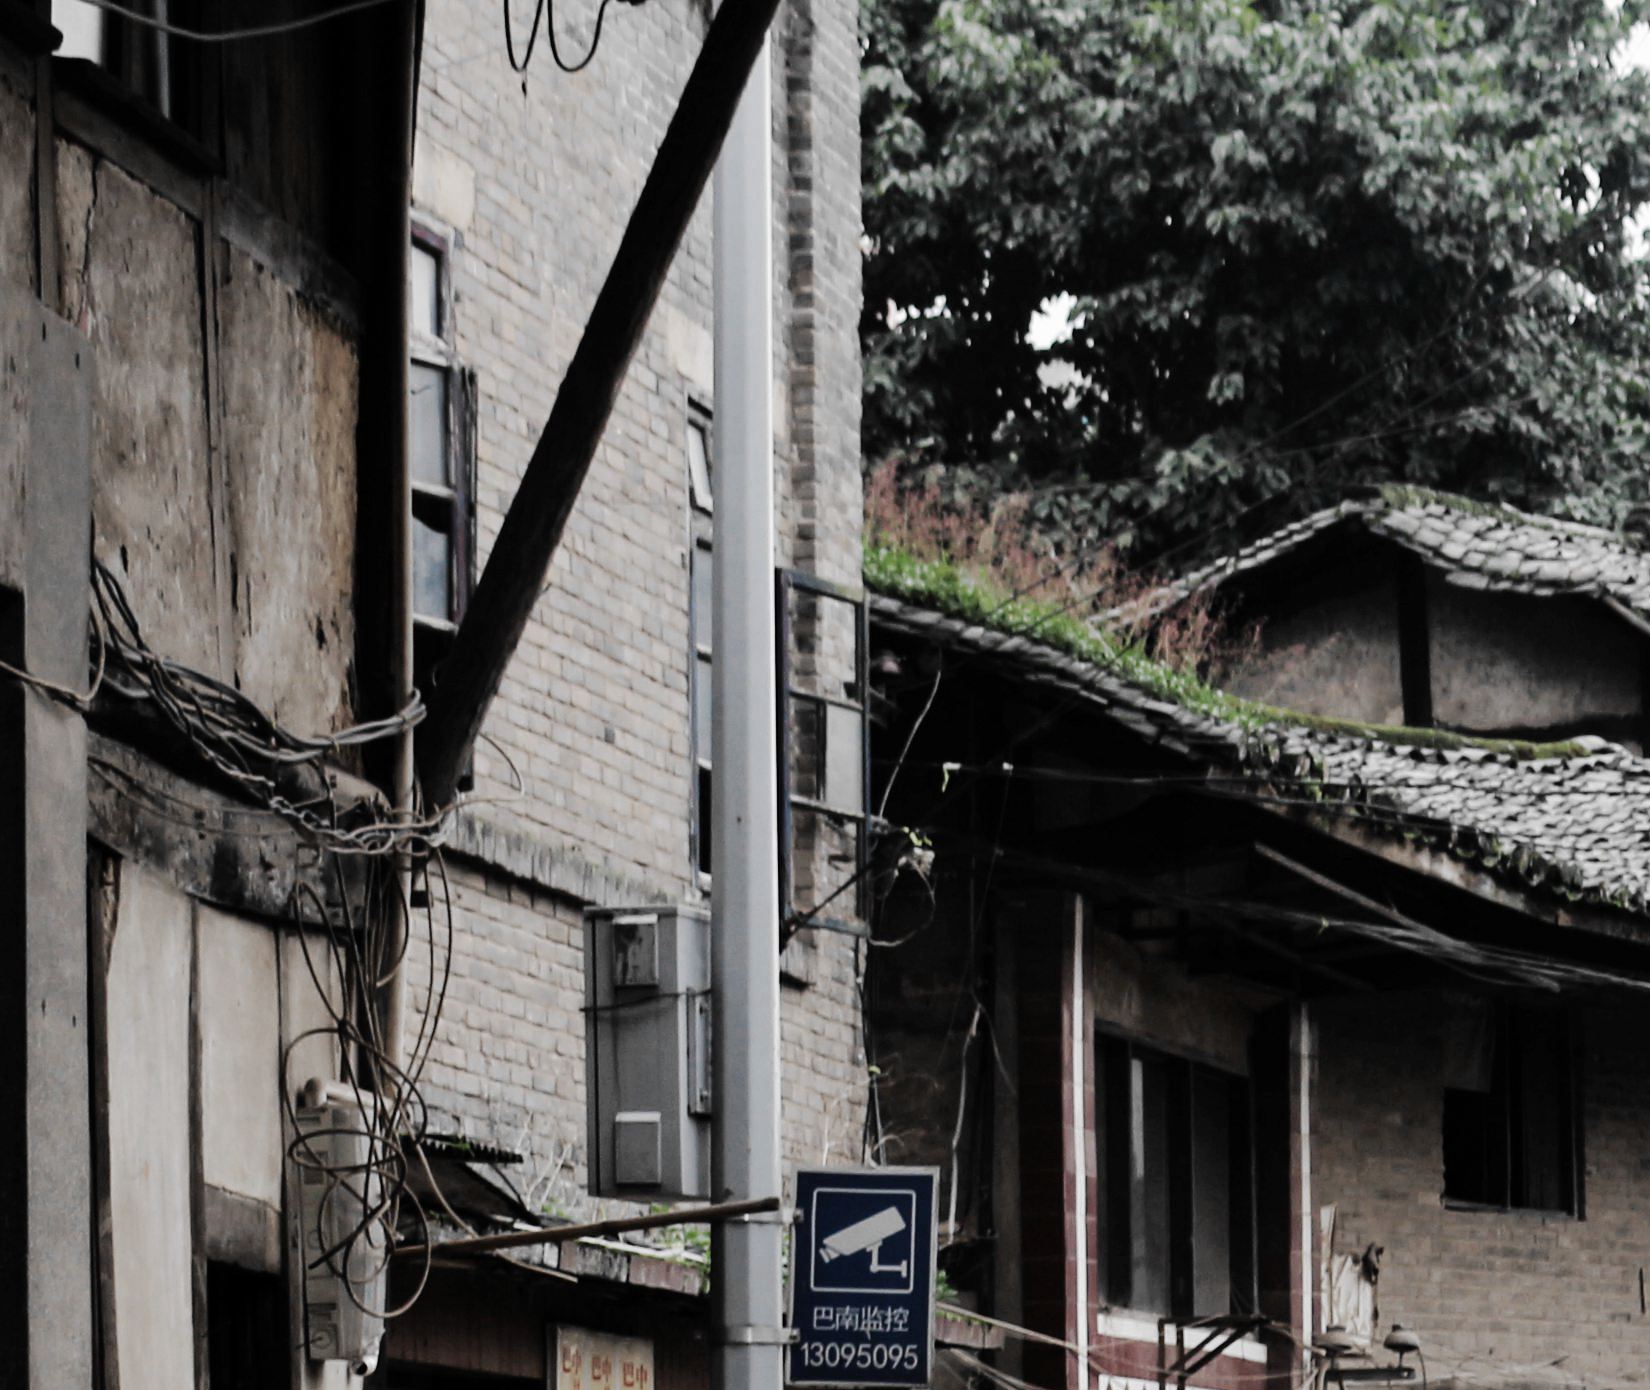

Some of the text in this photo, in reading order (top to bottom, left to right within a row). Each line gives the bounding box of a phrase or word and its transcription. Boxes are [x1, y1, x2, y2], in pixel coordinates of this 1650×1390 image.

[812, 1304, 910, 1333] 巴南监控
[801, 1341, 919, 1371] 13095095
